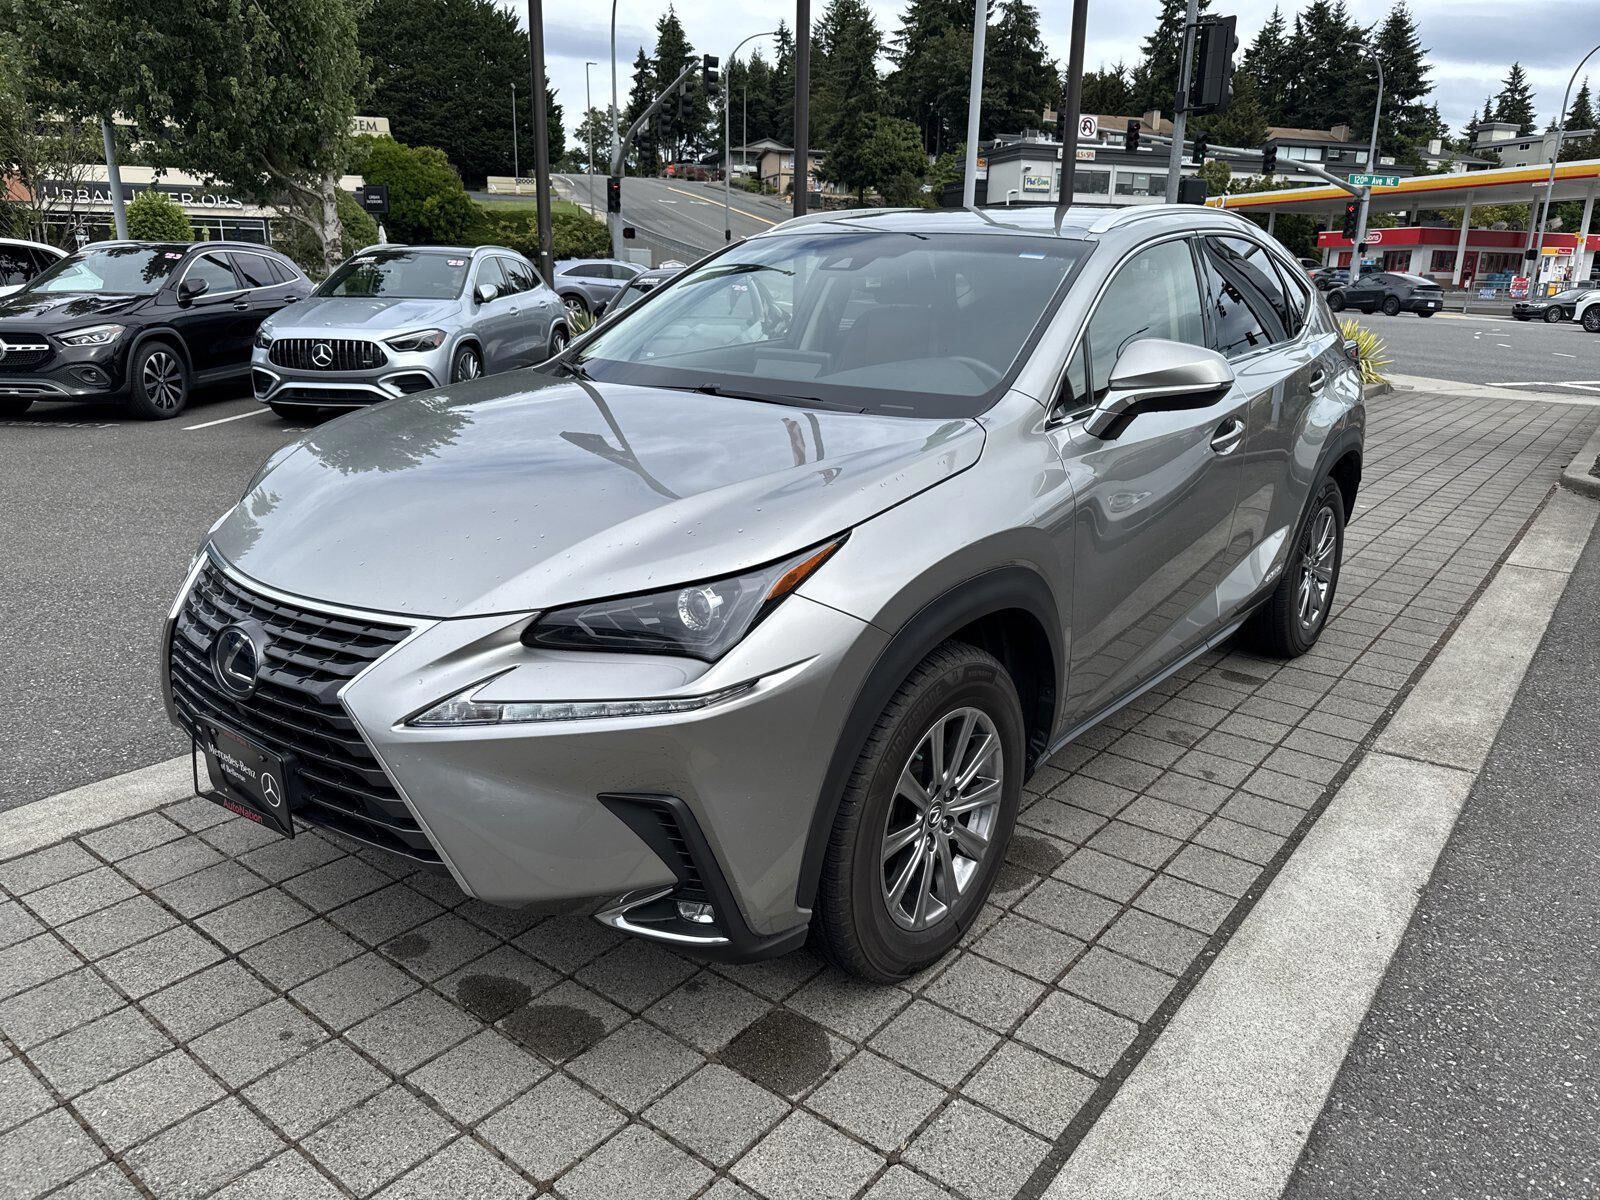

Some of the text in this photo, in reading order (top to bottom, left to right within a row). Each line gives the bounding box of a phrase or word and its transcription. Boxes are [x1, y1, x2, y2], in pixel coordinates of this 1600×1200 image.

[1371, 176, 1383, 186] Ave
[1386, 177, 1395, 186] NE
[131, 189, 243, 209] IERORS
[207, 741, 257, 779] Mercedes-Benz
[223, 797, 263, 824] AutoNation
